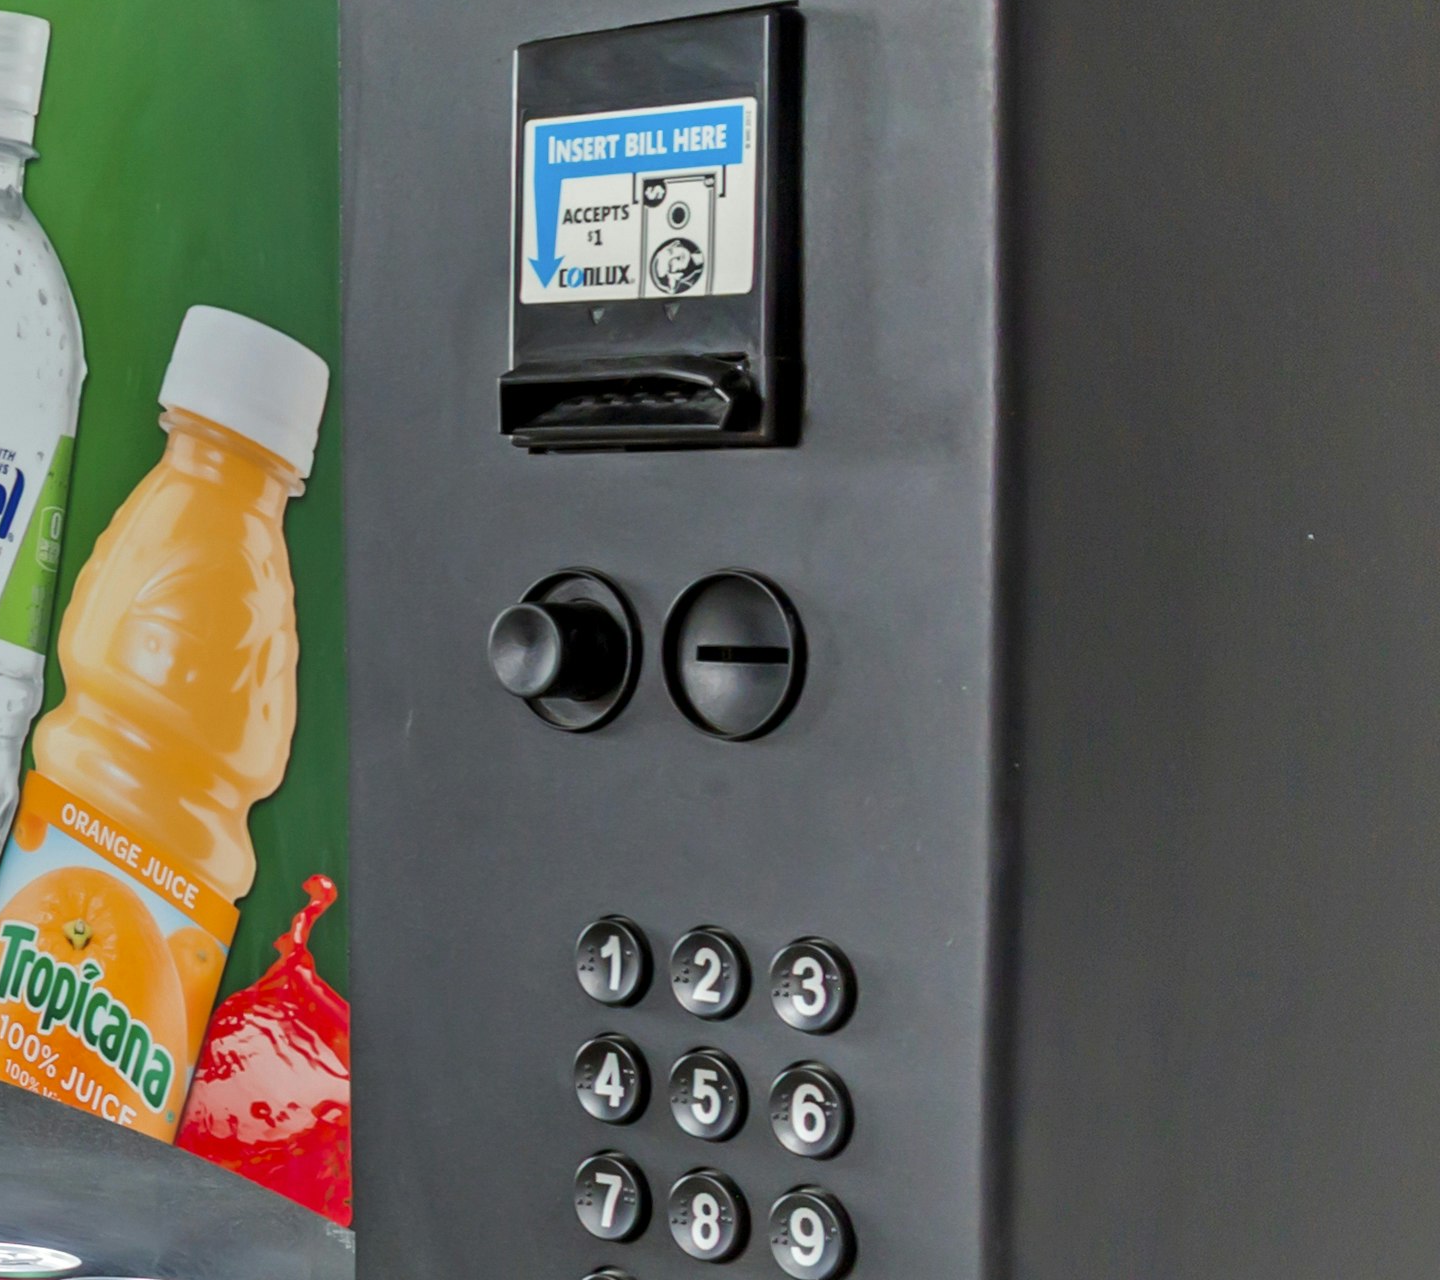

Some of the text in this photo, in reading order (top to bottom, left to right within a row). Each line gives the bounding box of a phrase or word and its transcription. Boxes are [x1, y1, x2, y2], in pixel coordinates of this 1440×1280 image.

[548, 124, 727, 164] INSERT BILL HERE
[562, 204, 630, 224] ACCEPTS
[587, 229, 603, 246] $1
[558, 264, 631, 288] CONLUX
[61, 803, 200, 910] ORANGE JUICE
[600, 935, 622, 990] 1
[692, 947, 721, 1002] 2
[792, 957, 824, 1016] 3
[594, 1052, 624, 1107] 4
[691, 1068, 720, 1124] 5
[792, 1084, 826, 1143] 6
[595, 1173, 622, 1227] 7
[691, 1192, 720, 1250] 8
[789, 1207, 824, 1266] 9
